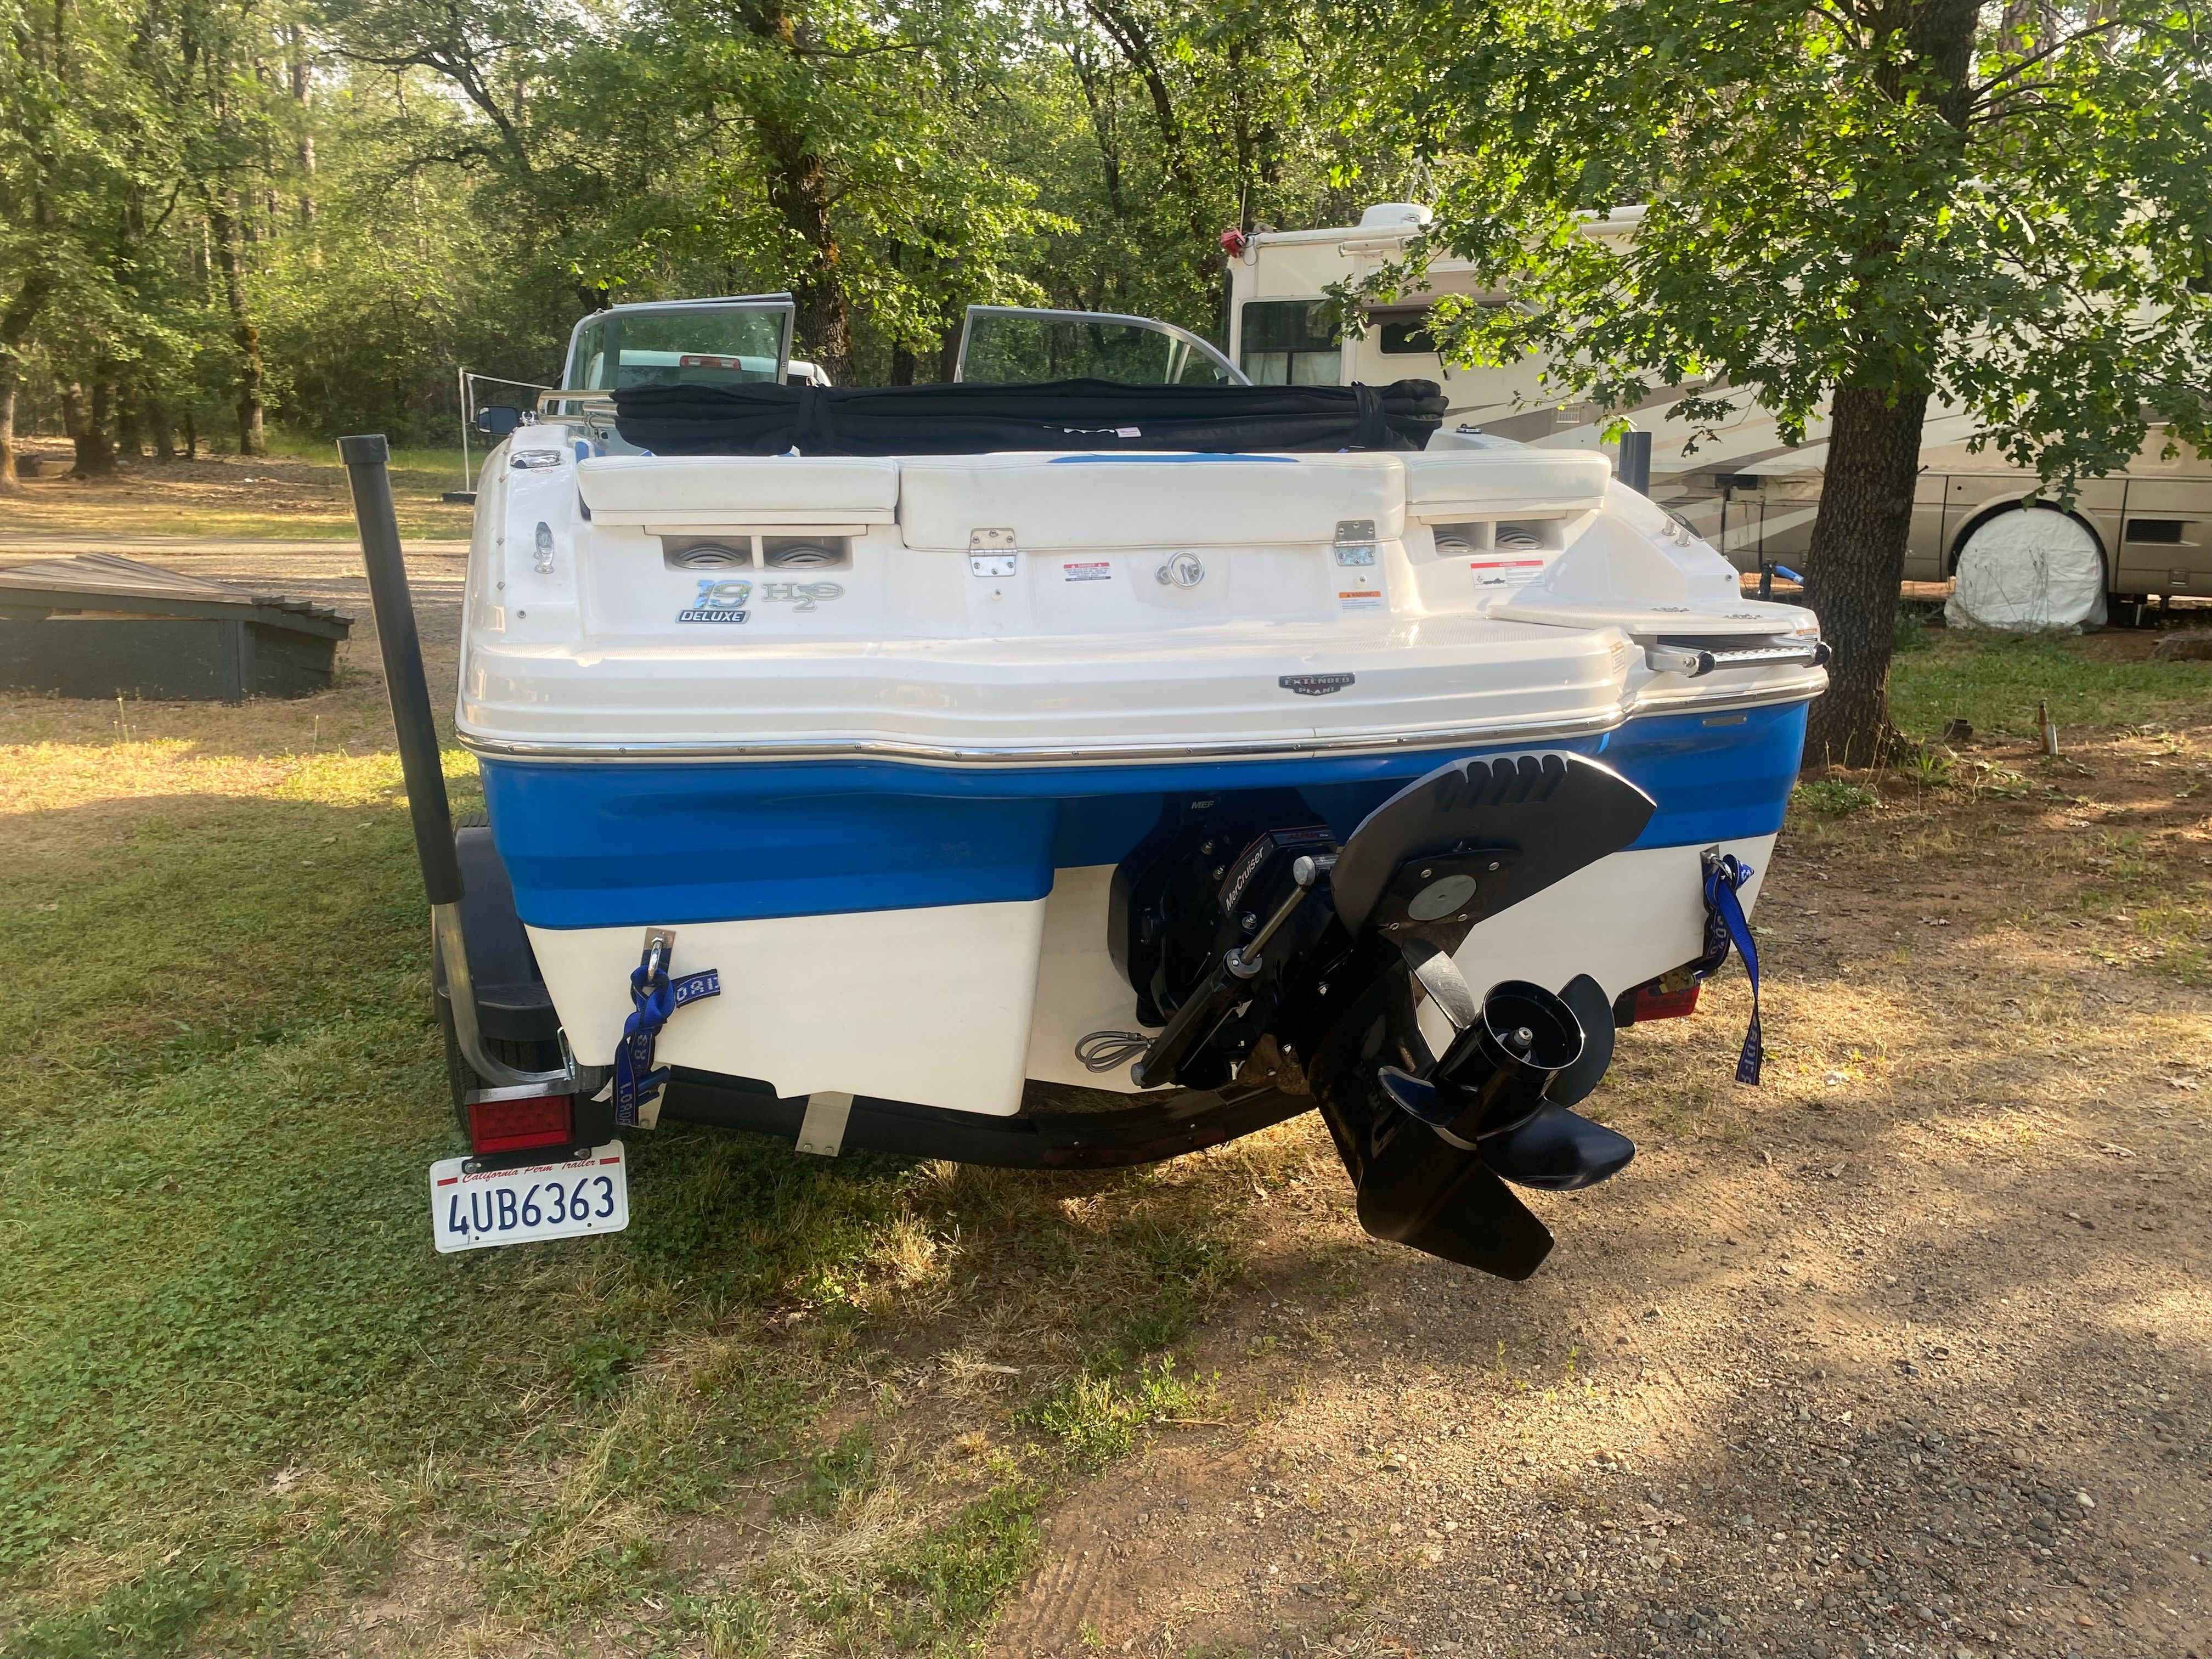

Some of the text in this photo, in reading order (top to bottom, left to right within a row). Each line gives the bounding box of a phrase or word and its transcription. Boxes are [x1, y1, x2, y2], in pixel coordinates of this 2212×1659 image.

[693, 579, 753, 610] 19
[681, 611, 744, 622] DELUXE
[1285, 678, 1350, 686] EXTENDED
[1226, 846, 1265, 912] MerCruiser
[462, 1160, 596, 1183] California Perm Trailer
[449, 1176, 614, 1235] 4UB6363
